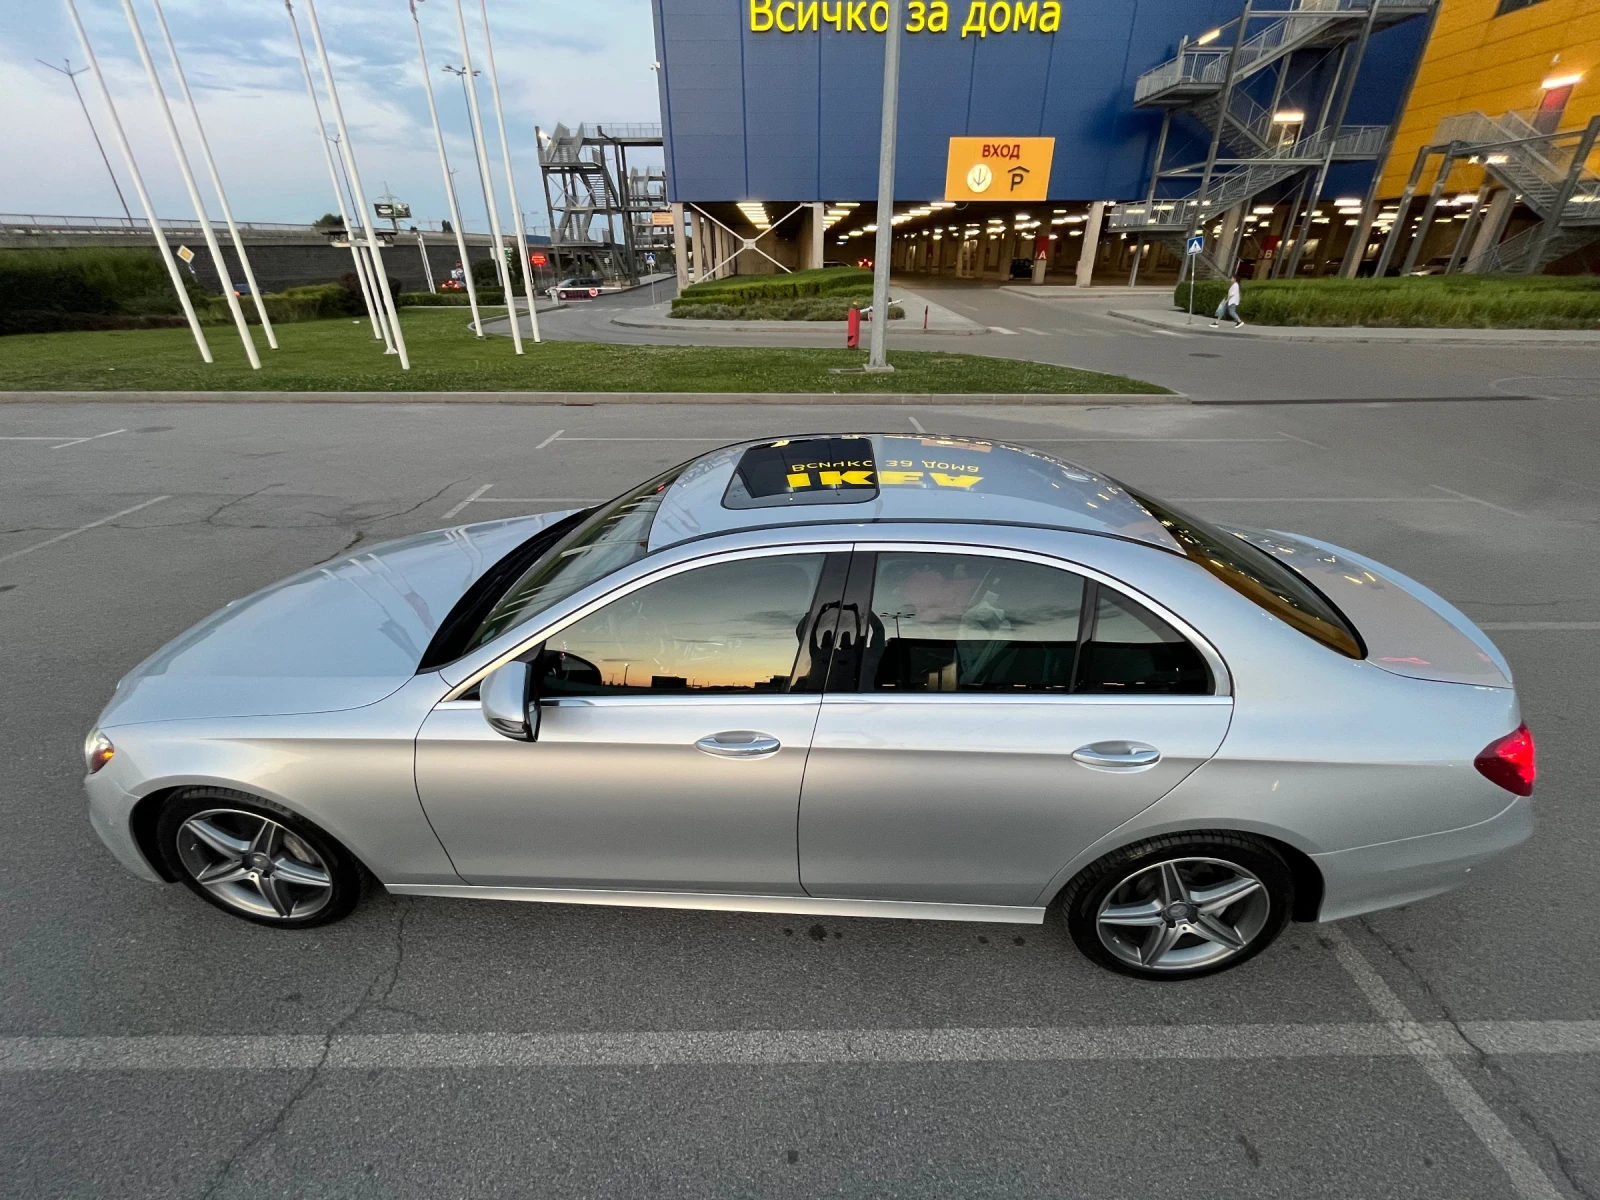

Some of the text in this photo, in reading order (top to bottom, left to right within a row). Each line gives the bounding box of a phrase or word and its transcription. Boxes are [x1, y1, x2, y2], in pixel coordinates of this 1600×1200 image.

[750, 0, 1061, 38] Всичко за дома
[982, 144, 1020, 160] ВХОД
[1010, 173, 1024, 192] P
[1038, 250, 1046, 260] A
